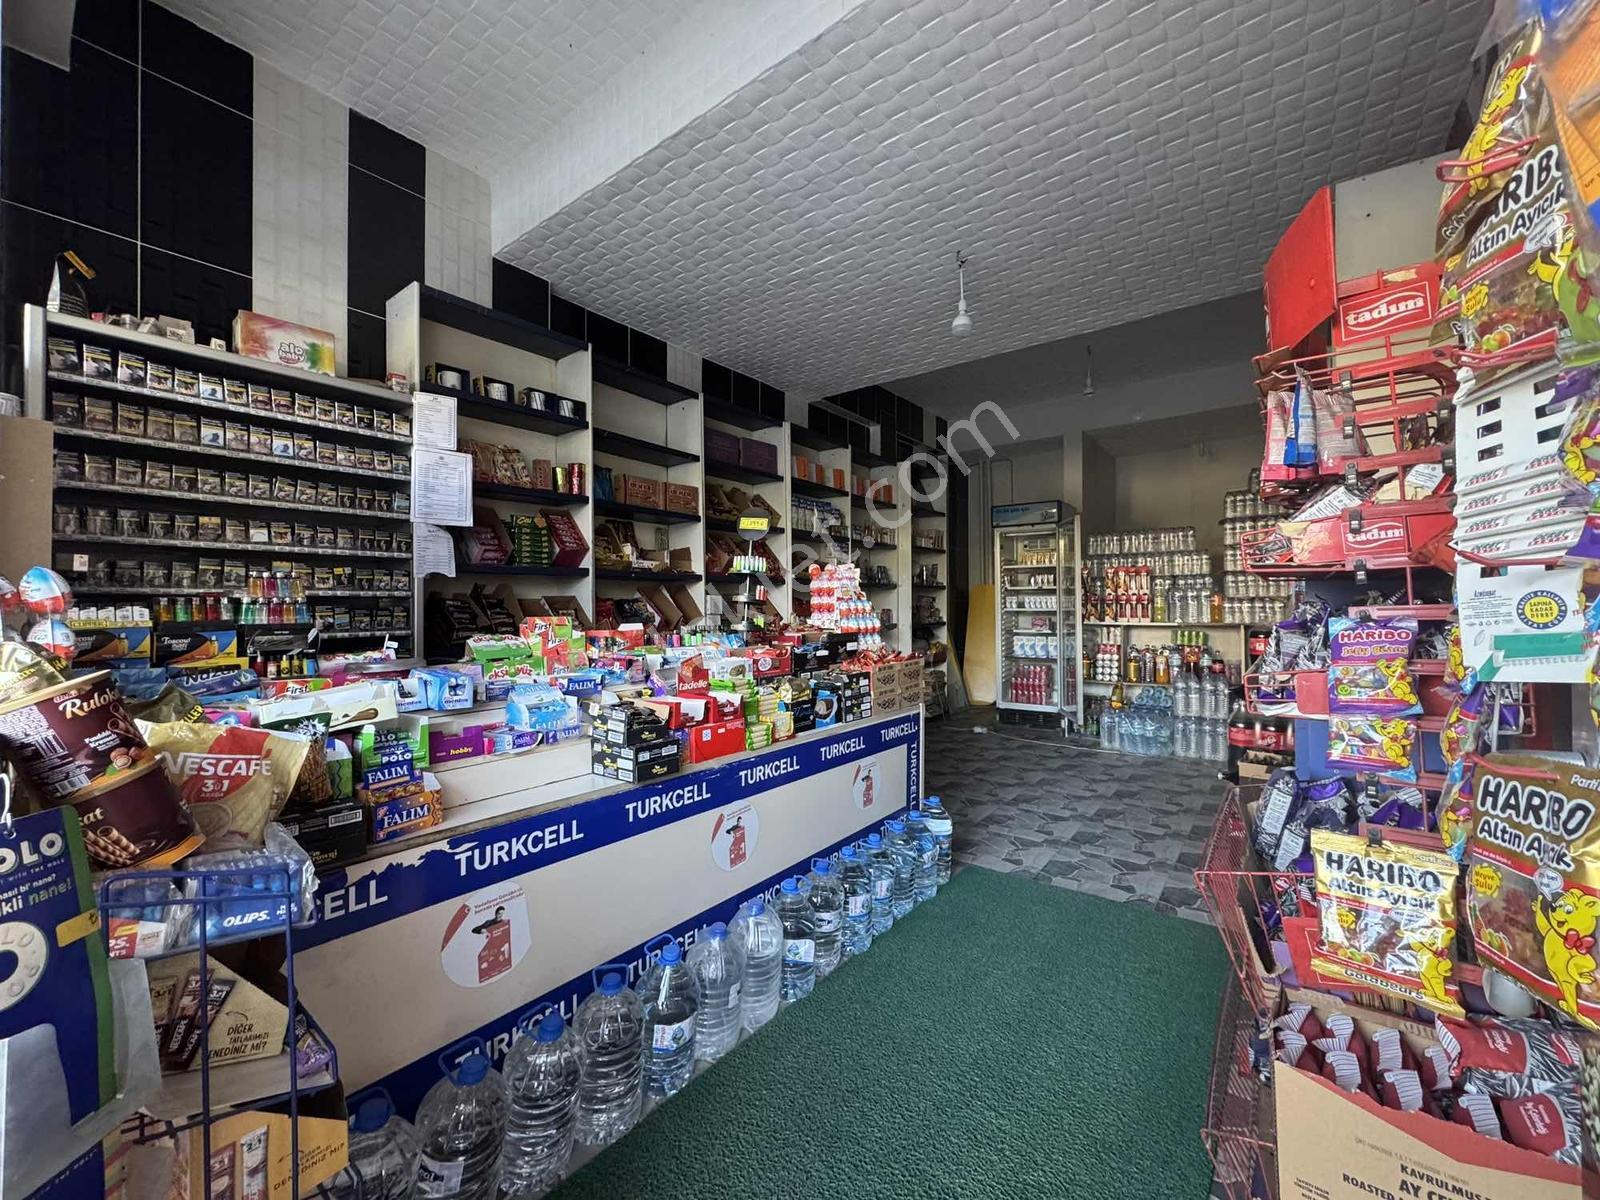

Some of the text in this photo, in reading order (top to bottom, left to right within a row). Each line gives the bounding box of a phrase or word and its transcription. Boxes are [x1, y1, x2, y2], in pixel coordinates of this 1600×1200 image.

[1345, 297, 1425, 326] tadım
[1338, 629, 1413, 643] HARIBO
[568, 681, 595, 691] FALIM
[678, 680, 708, 691] tadelle
[382, 752, 412, 764] POLO
[820, 736, 866, 762] TURKCELL
[367, 765, 409, 784] FALIM
[738, 755, 801, 787] TURKCELL
[625, 781, 711, 823] TURKCELL
[382, 804, 430, 829] FALIM
[454, 825, 584, 877] TURKCELL
[1325, 850, 1443, 893] HARIBO
[1343, 967, 1426, 1001] Goldbears
[208, 1044, 248, 1059] ENEDİNİZ
